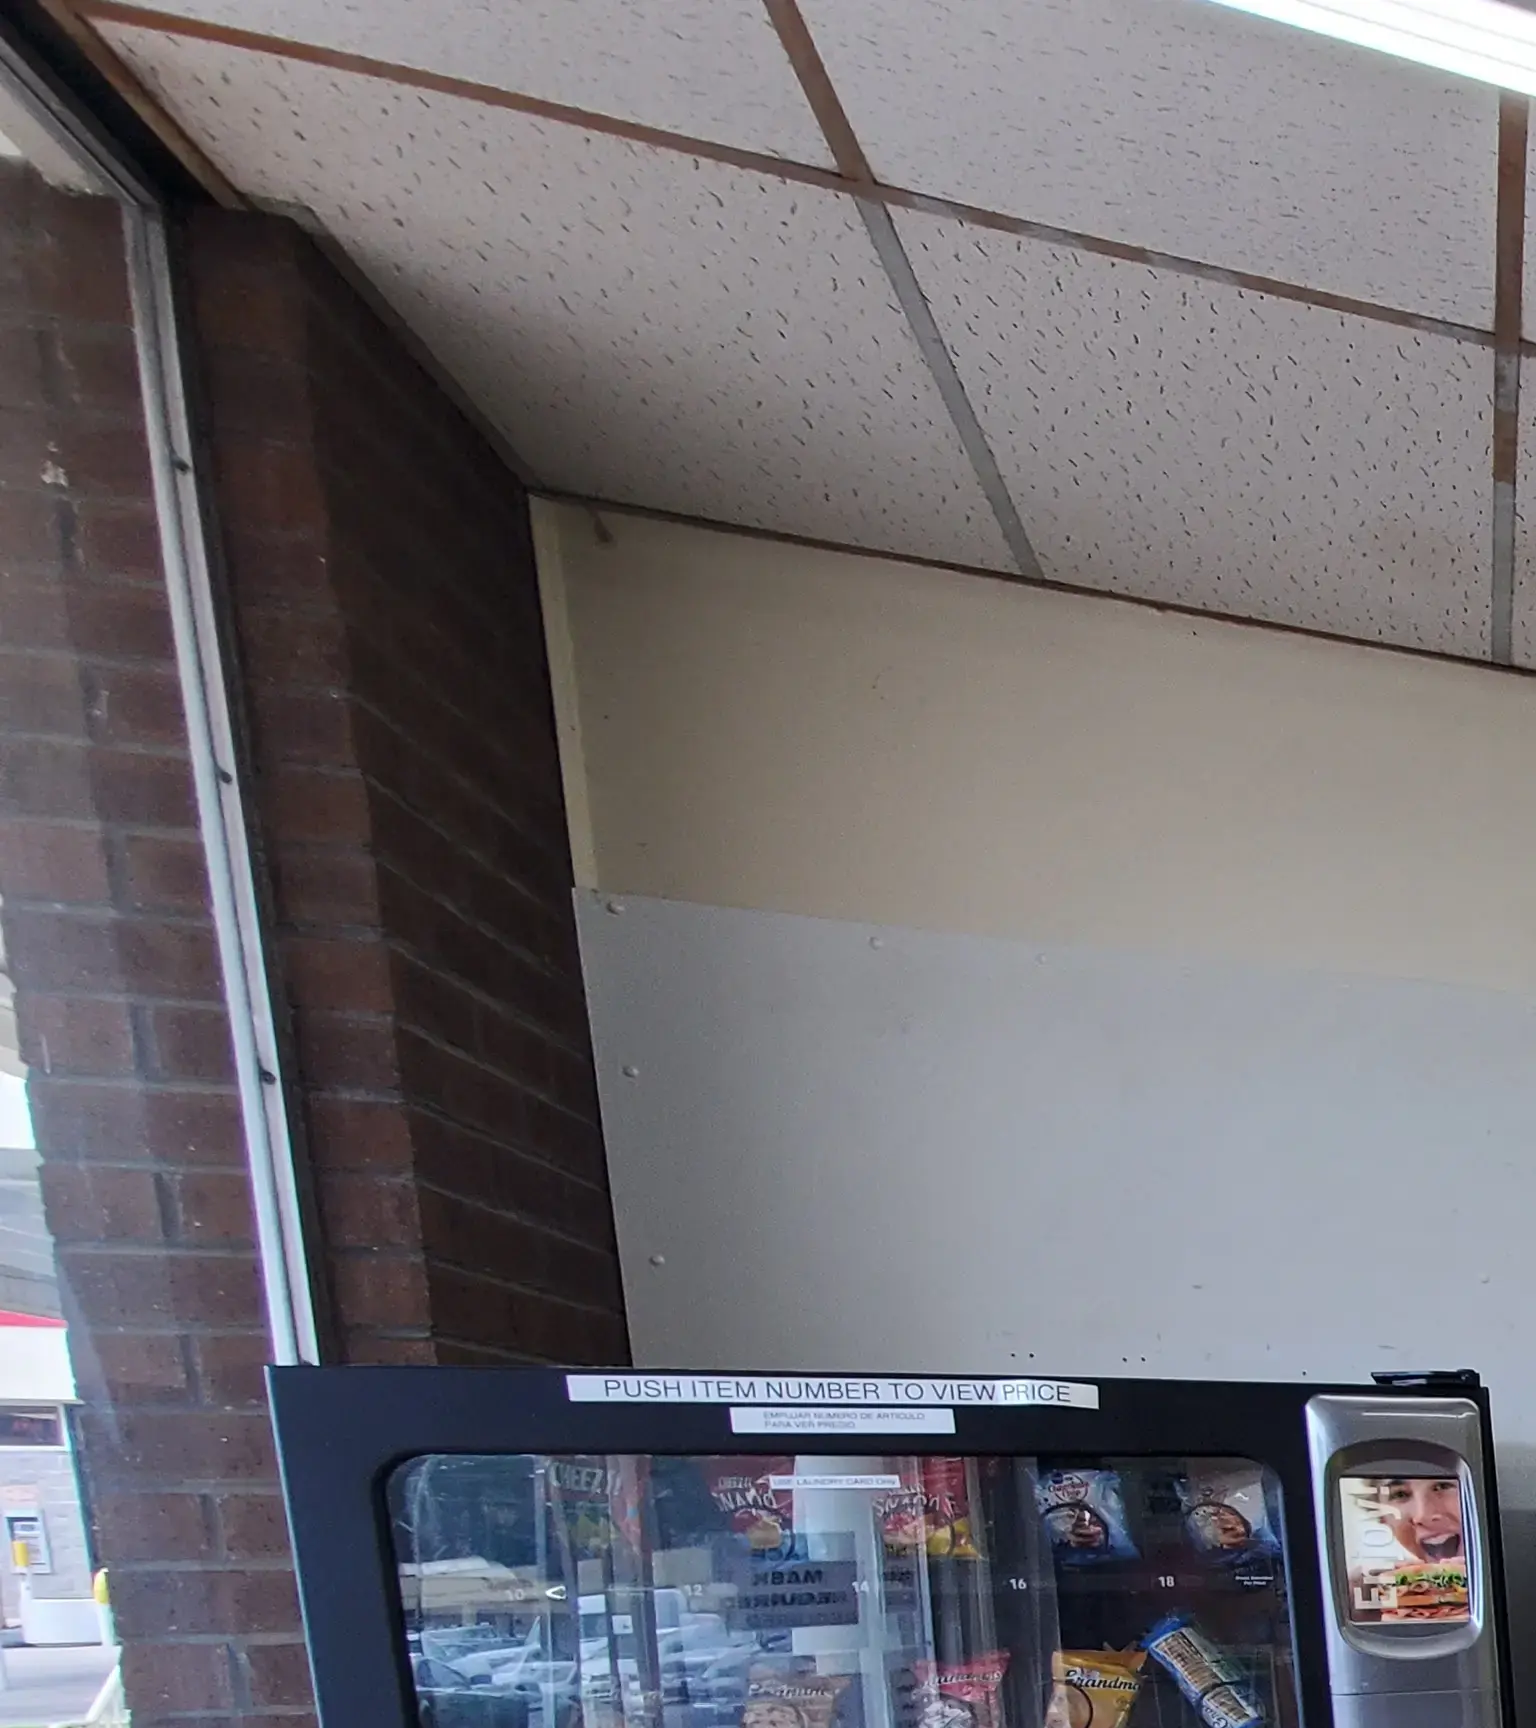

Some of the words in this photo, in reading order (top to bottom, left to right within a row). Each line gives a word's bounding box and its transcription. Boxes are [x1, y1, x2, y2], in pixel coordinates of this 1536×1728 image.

[602, 1378, 683, 1399] PUSH
[690, 1379, 758, 1400] ITEM
[765, 1379, 881, 1401] NUMBER
[891, 1381, 925, 1401] TO
[931, 1382, 996, 1403] VIEW
[1002, 1382, 1072, 1404] PRICE
[1008, 1577, 1028, 1592] 16
[1157, 1575, 1175, 1589] 18
